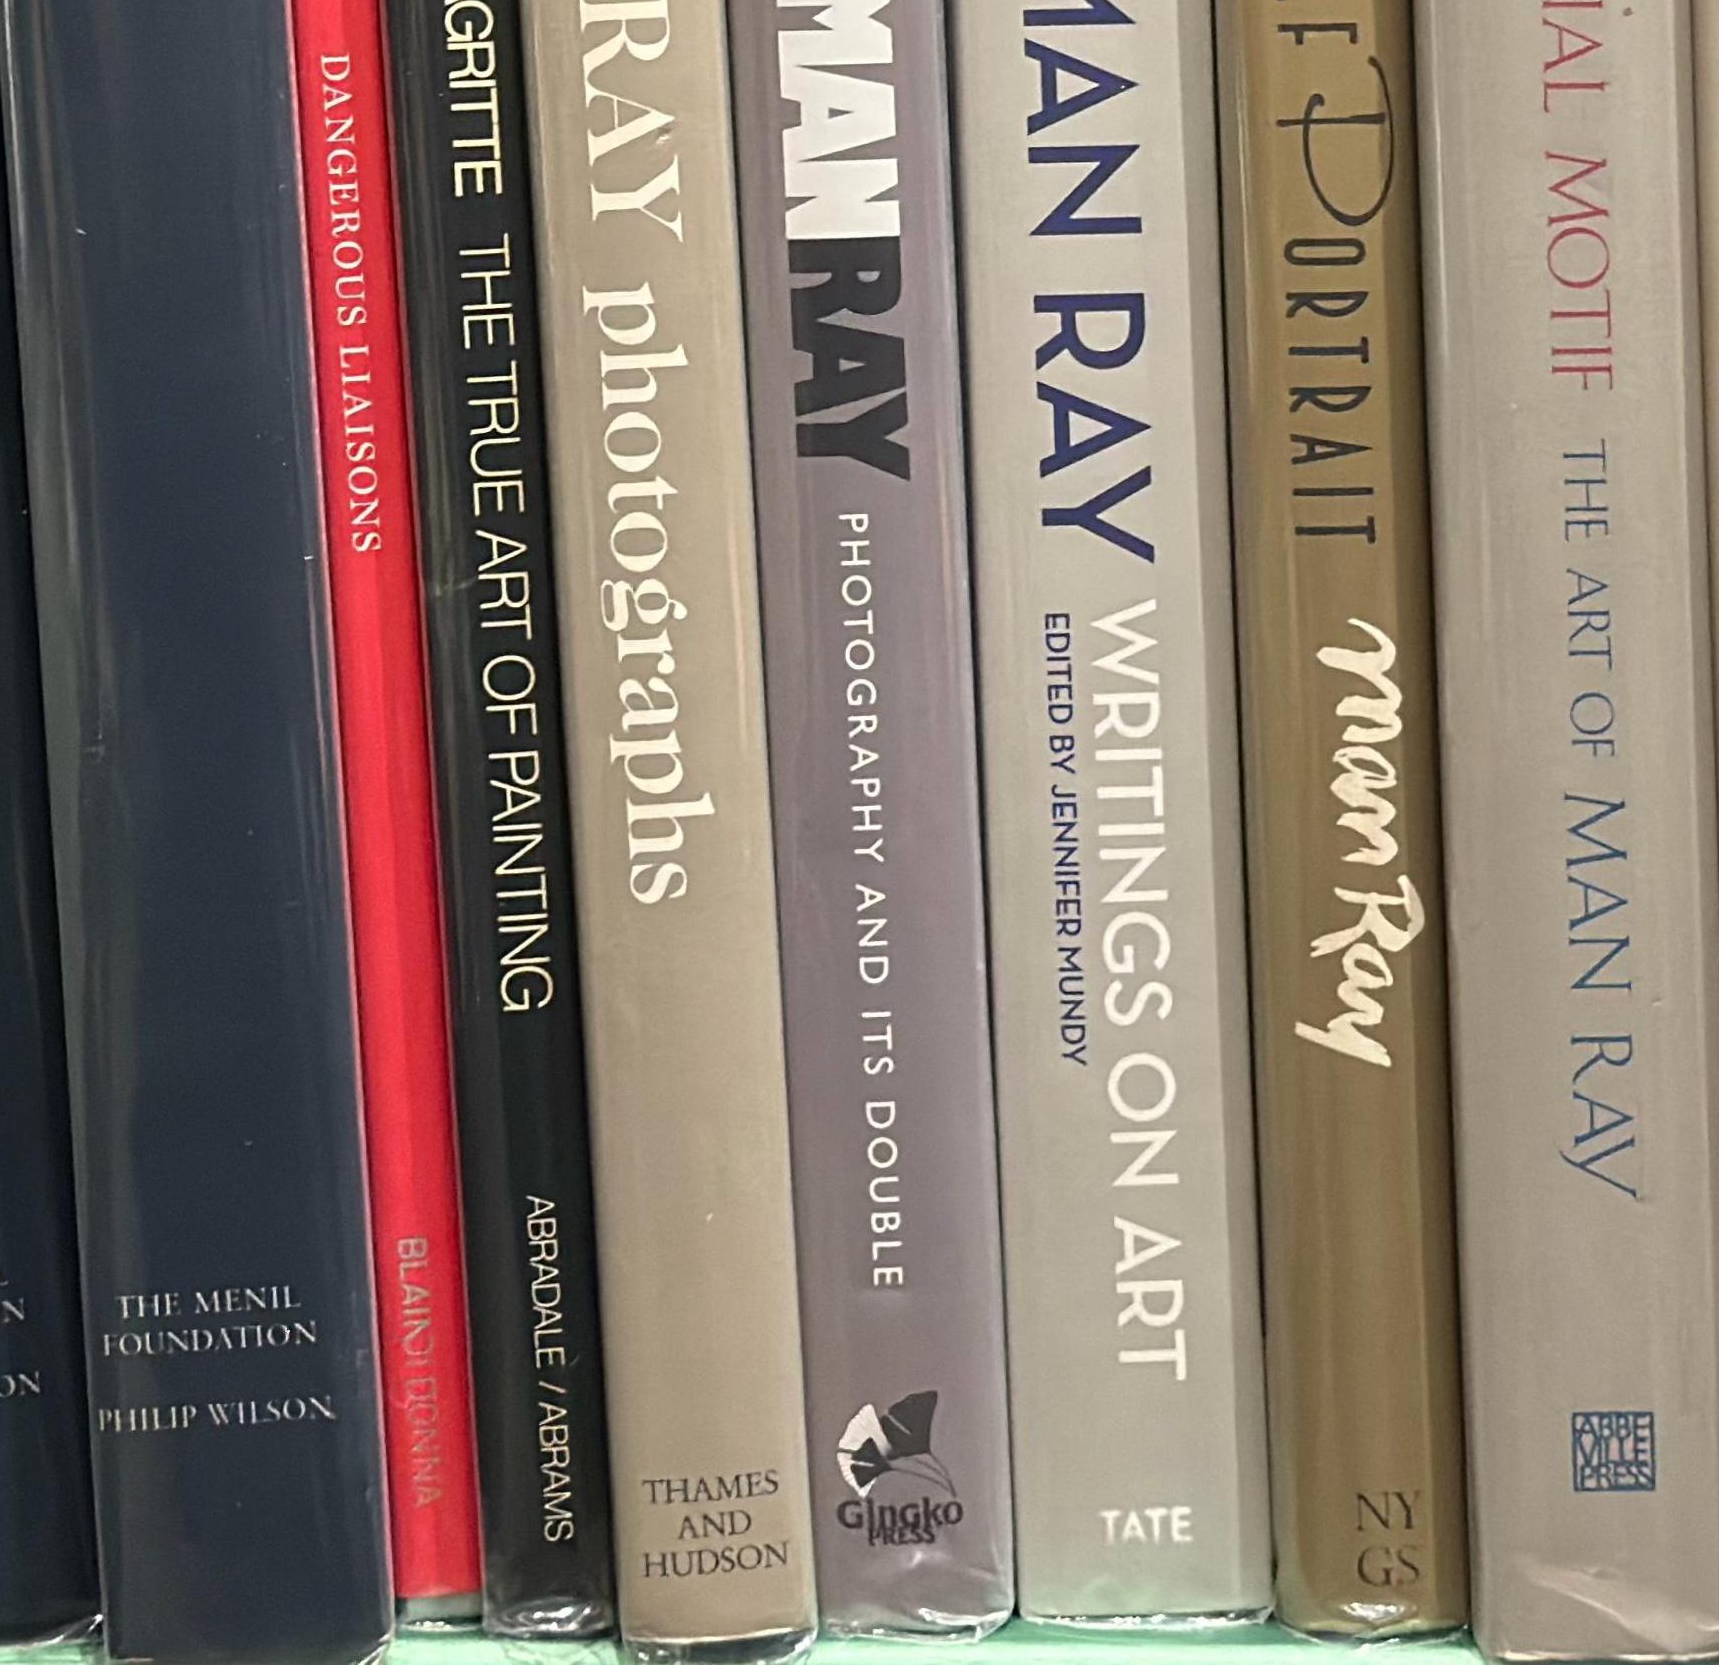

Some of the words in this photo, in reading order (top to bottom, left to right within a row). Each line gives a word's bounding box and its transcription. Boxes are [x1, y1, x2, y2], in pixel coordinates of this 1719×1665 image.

[321, 53, 367, 327] DANGEROUS
[458, 234, 515, 349] THE
[1544, 150, 1614, 391] MOTIF
[339, 345, 382, 554] LIAISONS
[466, 371, 524, 516] TRUE
[1033, 291, 1156, 564] RAY
[1562, 439, 1609, 542] THE
[474, 530, 533, 640] ART
[582, 281, 716, 906] photographs
[1565, 567, 1613, 671] ART
[482, 655, 539, 735] OF
[838, 512, 886, 865] PHOTOGRAPHY
[1044, 613, 1074, 726] EDITED
[1568, 691, 1615, 758] OF
[1050, 735, 1076, 775] BY
[1091, 598, 1174, 1028] WRITINGS
[487, 748, 554, 1011] PAINTING
[1051, 786, 1083, 940] JENNIFER
[1563, 792, 1632, 993] MAN
[855, 883, 890, 986] AND
[1294, 874, 1425, 1068] Ray
[861, 1010, 894, 1076] ITS
[1057, 946, 1089, 1067] MUNDY
[1107, 1051, 1181, 1188] ON
[1559, 1034, 1638, 1199] RAY
[865, 1099, 904, 1290] DOUBLE
[103, 1319, 317, 1358] FOUNDATION
[116, 1293, 179, 1320] THE
[194, 1285, 301, 1314] MENIL
[527, 1195, 566, 1368] ABRADALE
[1113, 1216, 1187, 1382] ART
[98, 1404, 197, 1432] PHILIP
[208, 1394, 336, 1427] WILSON
[539, 1400, 574, 1541] ABRAMS
[642, 1471, 779, 1505] THAMES
[678, 1511, 752, 1540] AND
[1100, 1505, 1194, 1545] TATE
[1355, 1490, 1421, 1530] NY
[643, 1543, 791, 1579] HUDSON
[1356, 1546, 1422, 1588] GS
